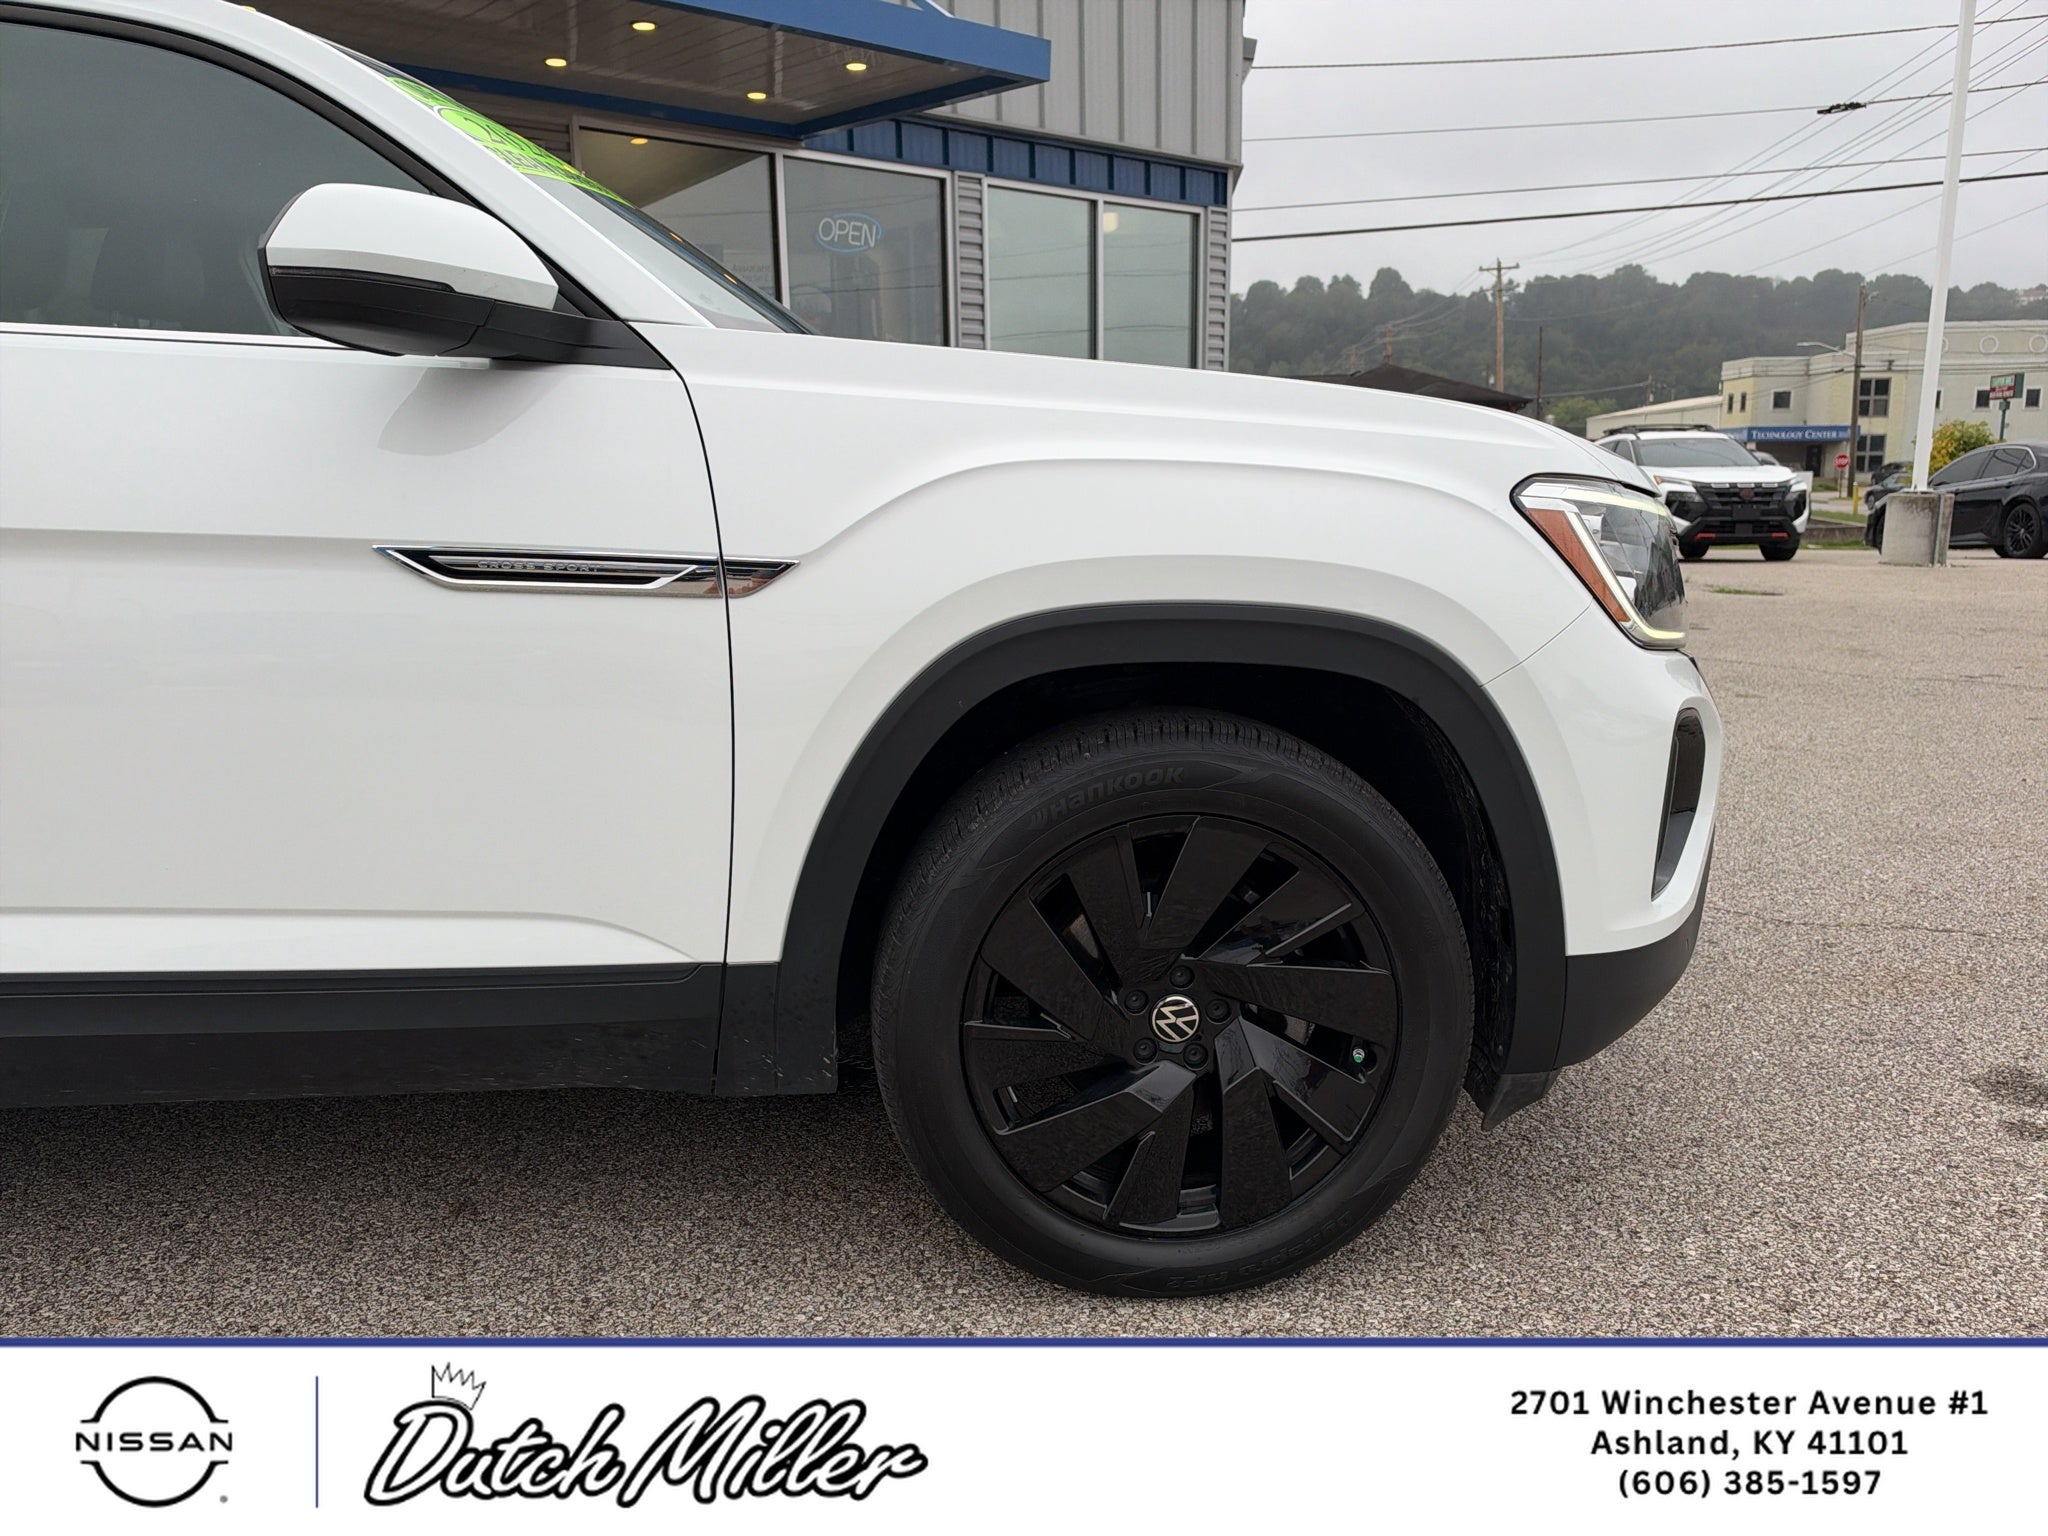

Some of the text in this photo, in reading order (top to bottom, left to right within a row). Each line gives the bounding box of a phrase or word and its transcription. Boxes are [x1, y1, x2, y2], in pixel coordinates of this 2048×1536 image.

[818, 217, 877, 248] OPEN
[477, 560, 601, 573] CROSS SPORT
